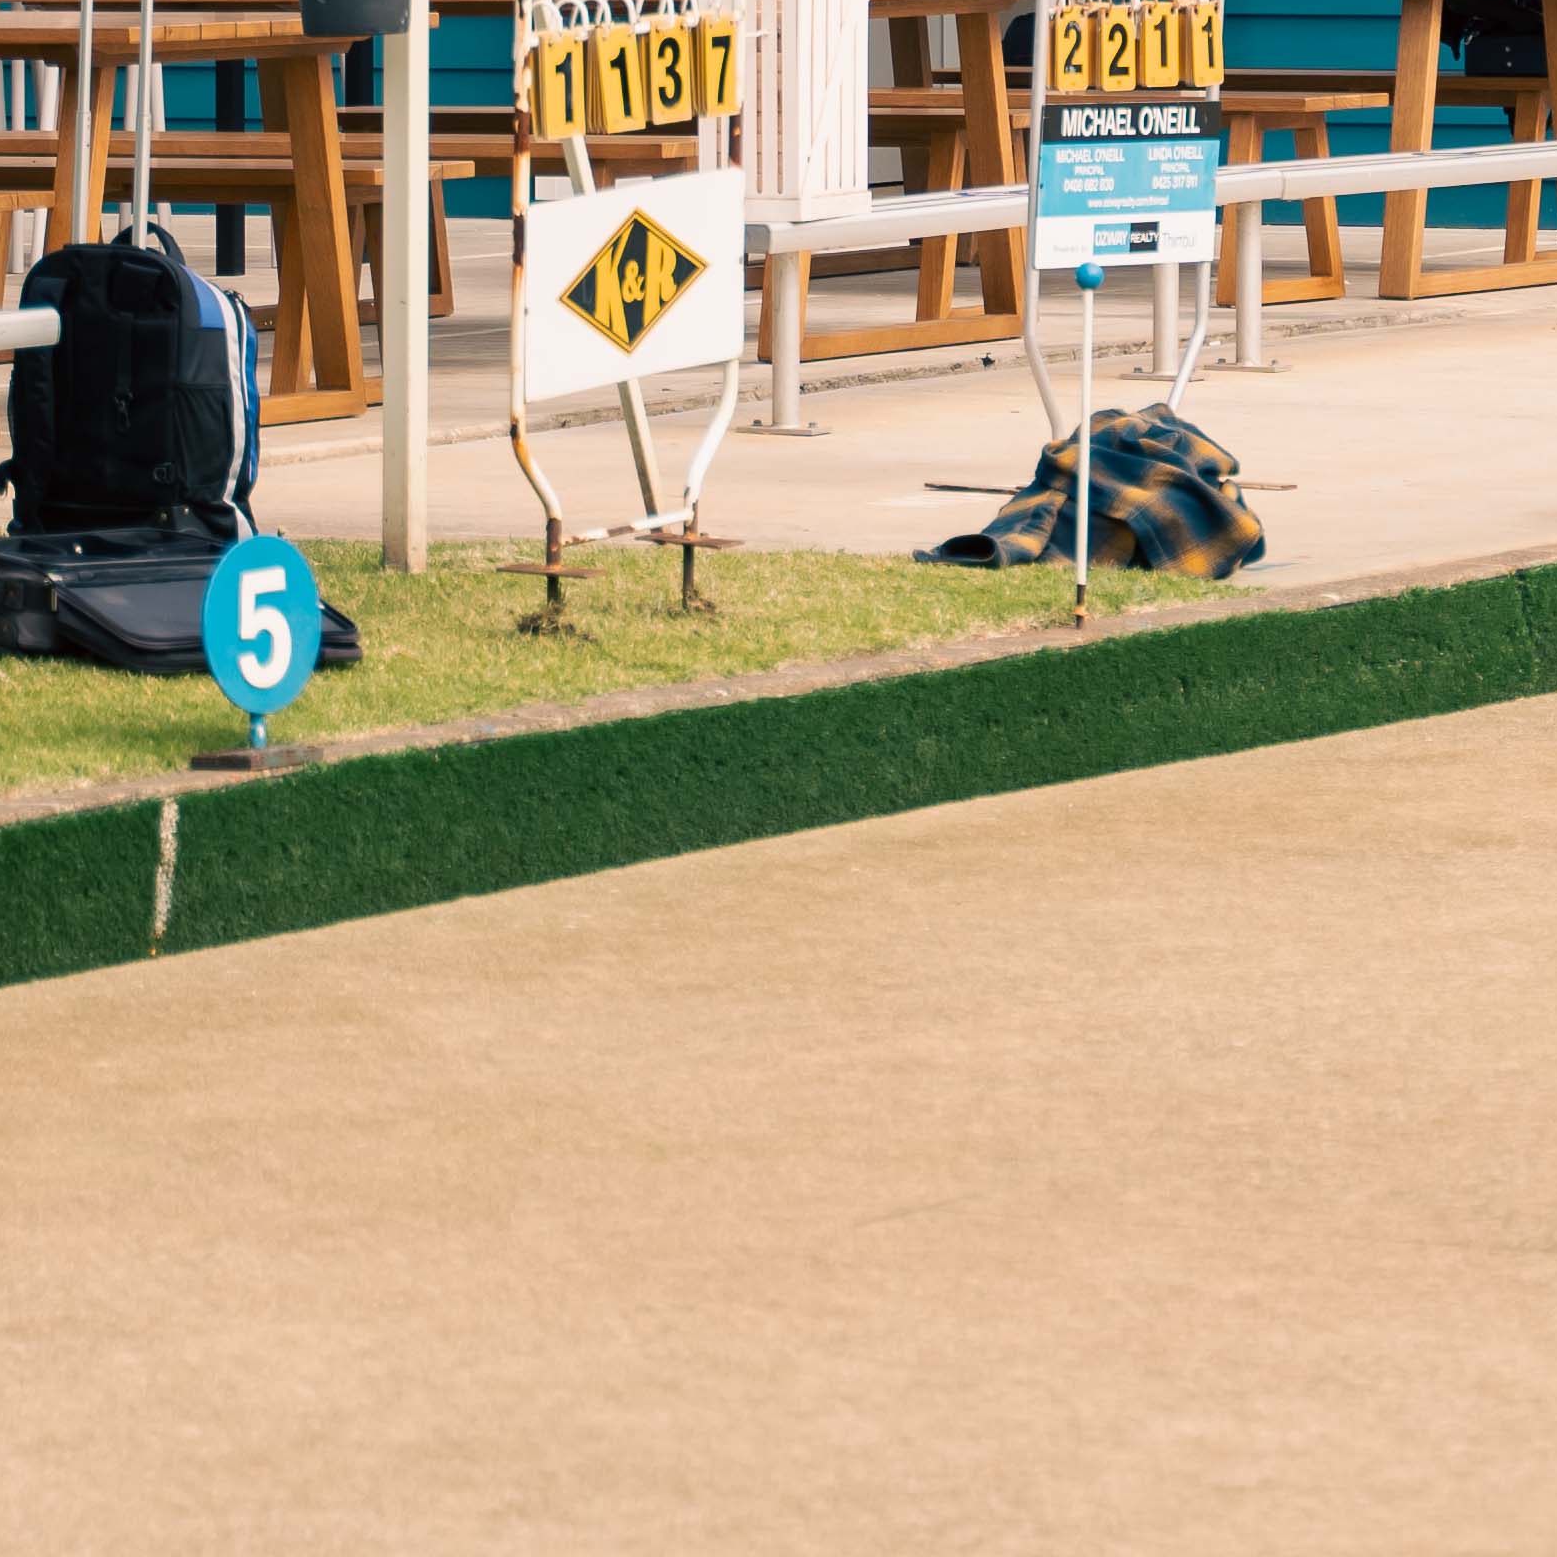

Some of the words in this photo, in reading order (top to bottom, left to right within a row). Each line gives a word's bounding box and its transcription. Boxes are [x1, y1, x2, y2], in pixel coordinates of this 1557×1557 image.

[1060, 107, 1137, 138] MICHAEL
[1138, 105, 1201, 135] O'NEILL
[1130, 231, 1160, 244] REALTY
[238, 565, 292, 691] 5
